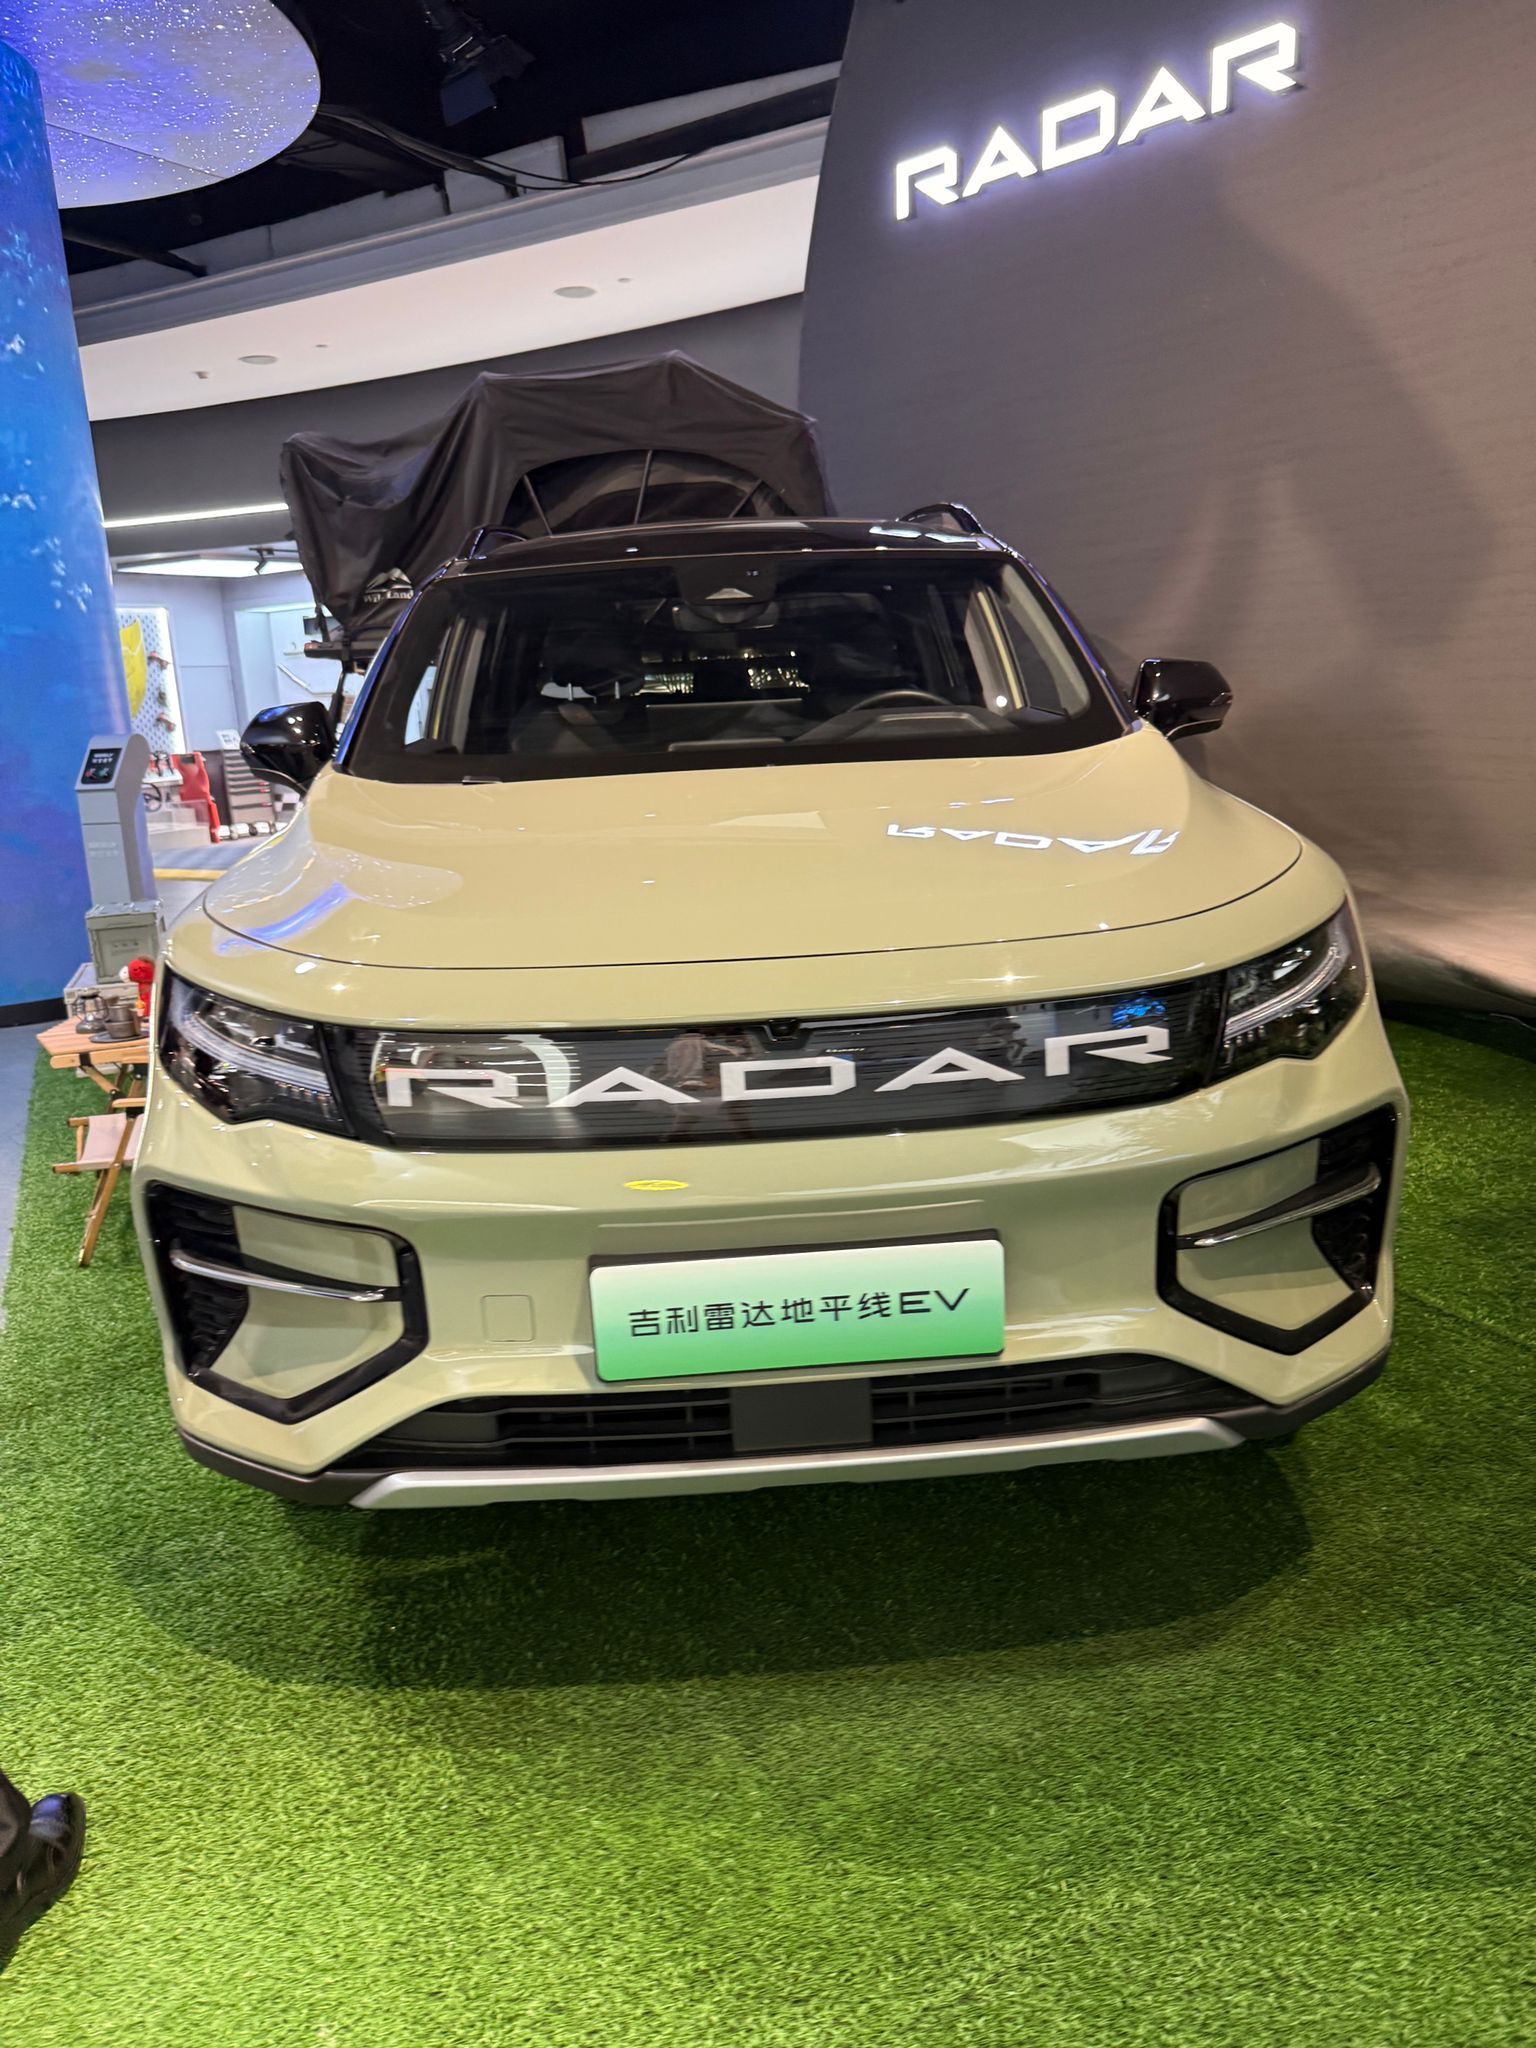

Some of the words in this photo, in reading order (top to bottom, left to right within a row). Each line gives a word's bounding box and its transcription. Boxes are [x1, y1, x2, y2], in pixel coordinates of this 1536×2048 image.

[896, 22, 1297, 220] RADAR
[385, 1025, 1174, 1109] RADAR
[628, 1287, 971, 1338] 吉利雷达地平线EV
